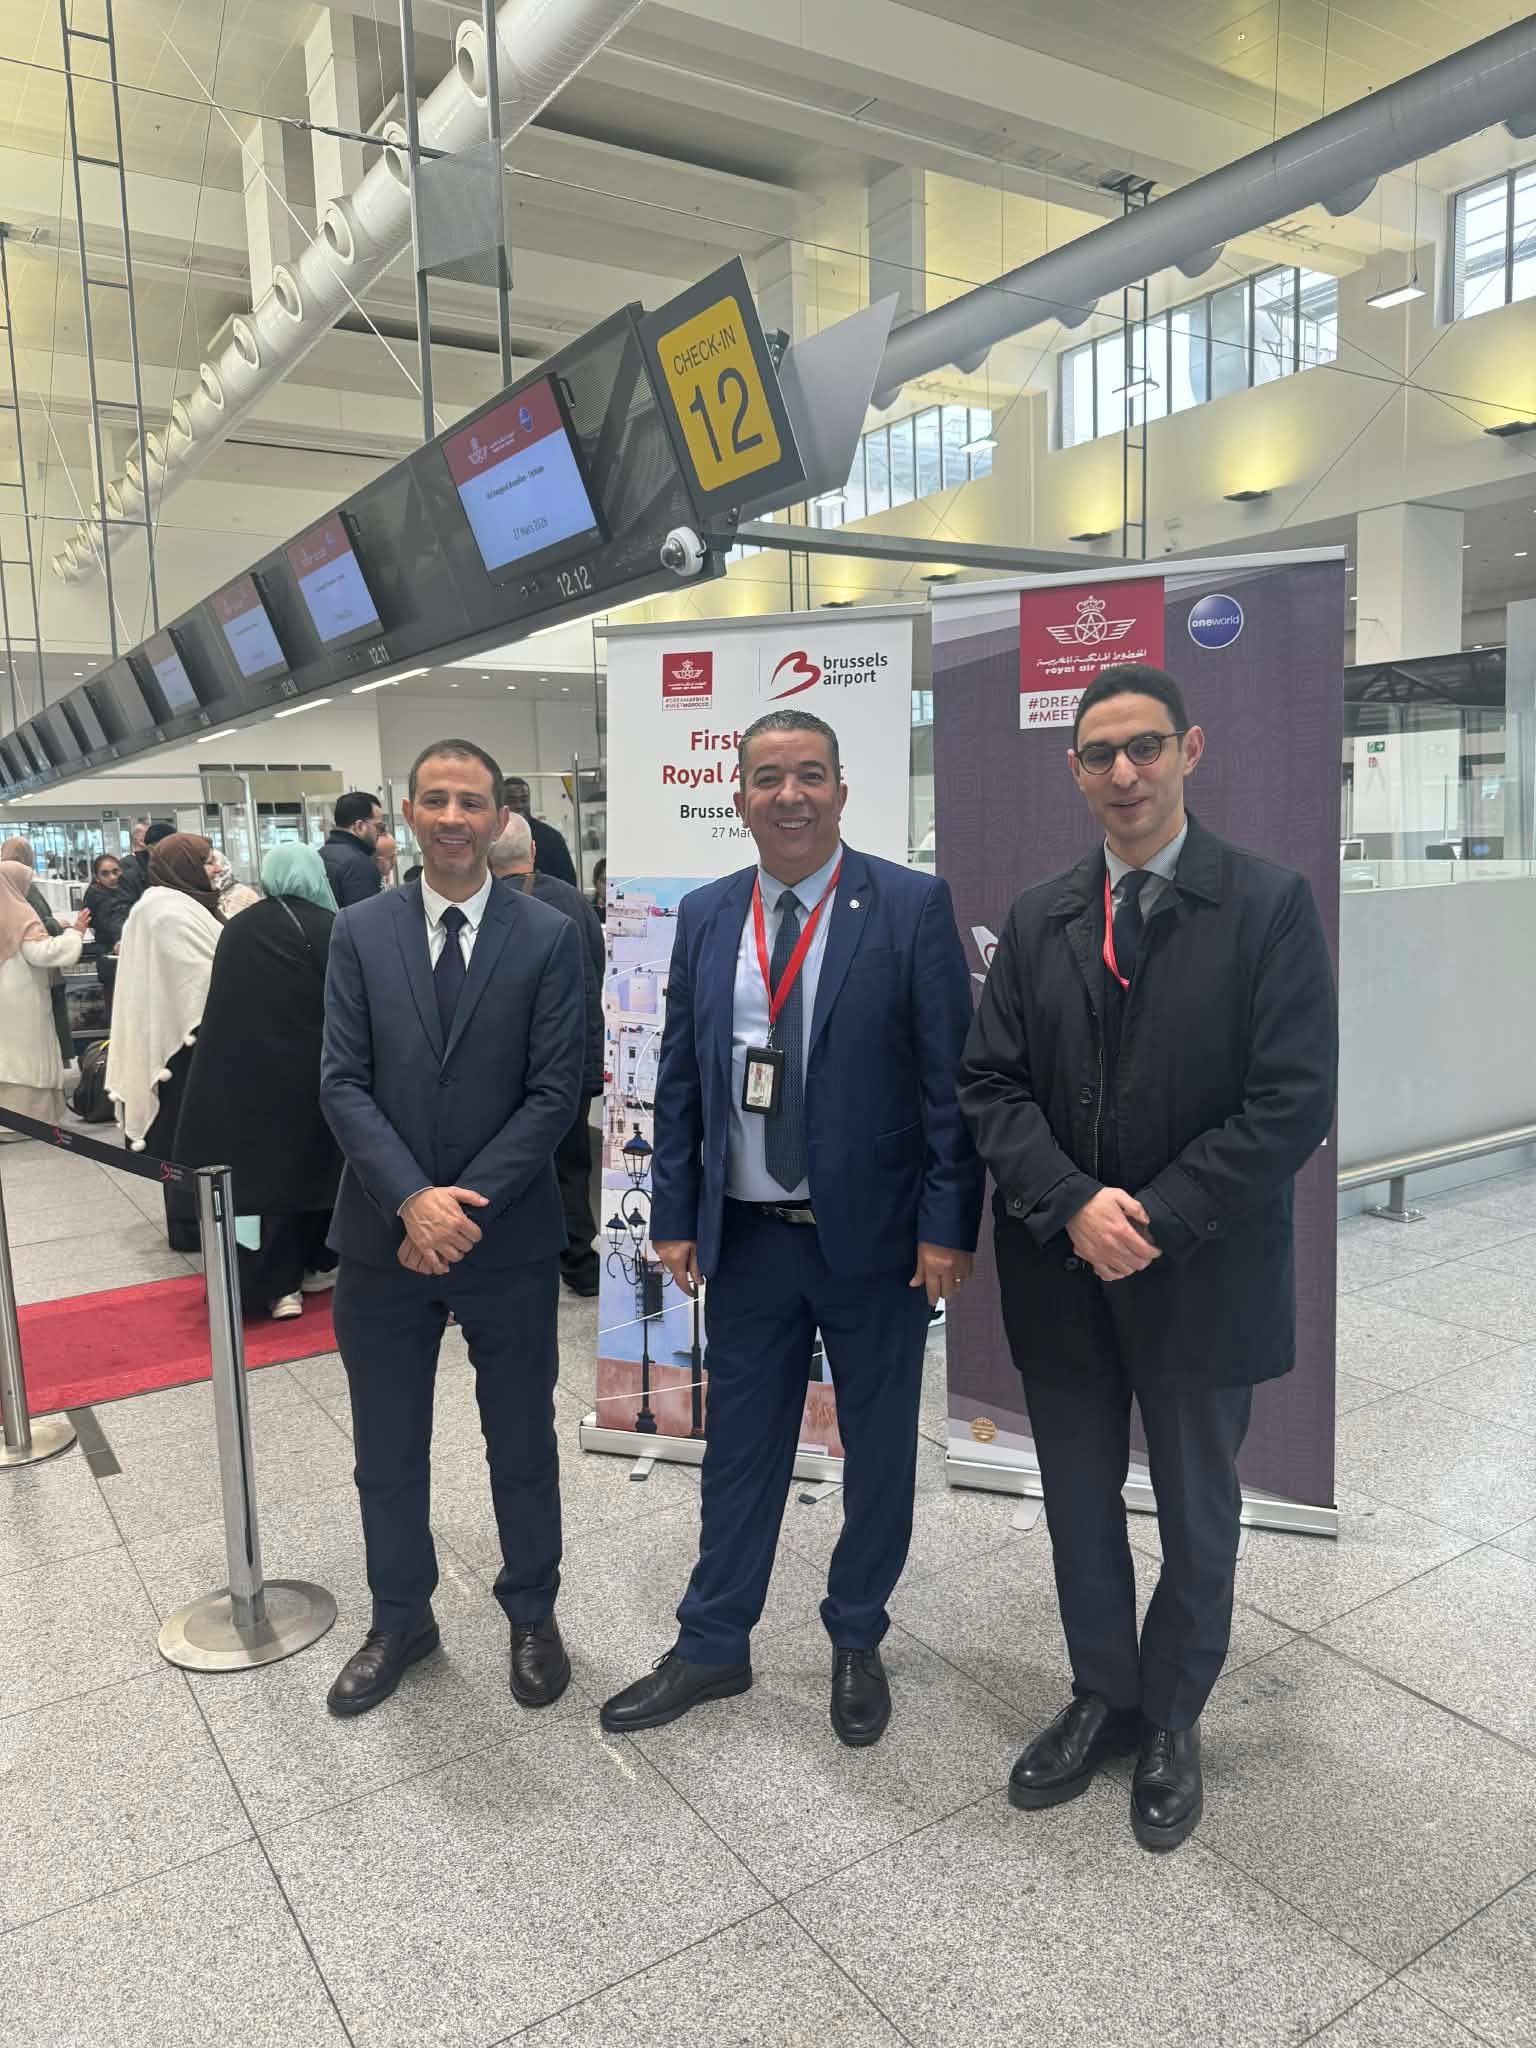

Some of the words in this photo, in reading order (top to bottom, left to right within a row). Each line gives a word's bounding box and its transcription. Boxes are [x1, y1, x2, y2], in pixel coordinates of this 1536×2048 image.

[673, 325, 736, 376] CHECK-IN
[689, 367, 763, 463] 12
[1191, 614, 1240, 628] oneworld
[823, 651, 888, 669] brussels
[1045, 665, 1075, 675] royal
[1079, 664, 1096, 673] air
[823, 670, 877, 688] airport
[1028, 695, 1080, 709] #DREA
[1028, 708, 1076, 722] #MEET
[691, 729, 741, 751] First
[662, 762, 723, 788] Royal
[712, 827, 725, 838] 27
[728, 827, 751, 838] Mar
